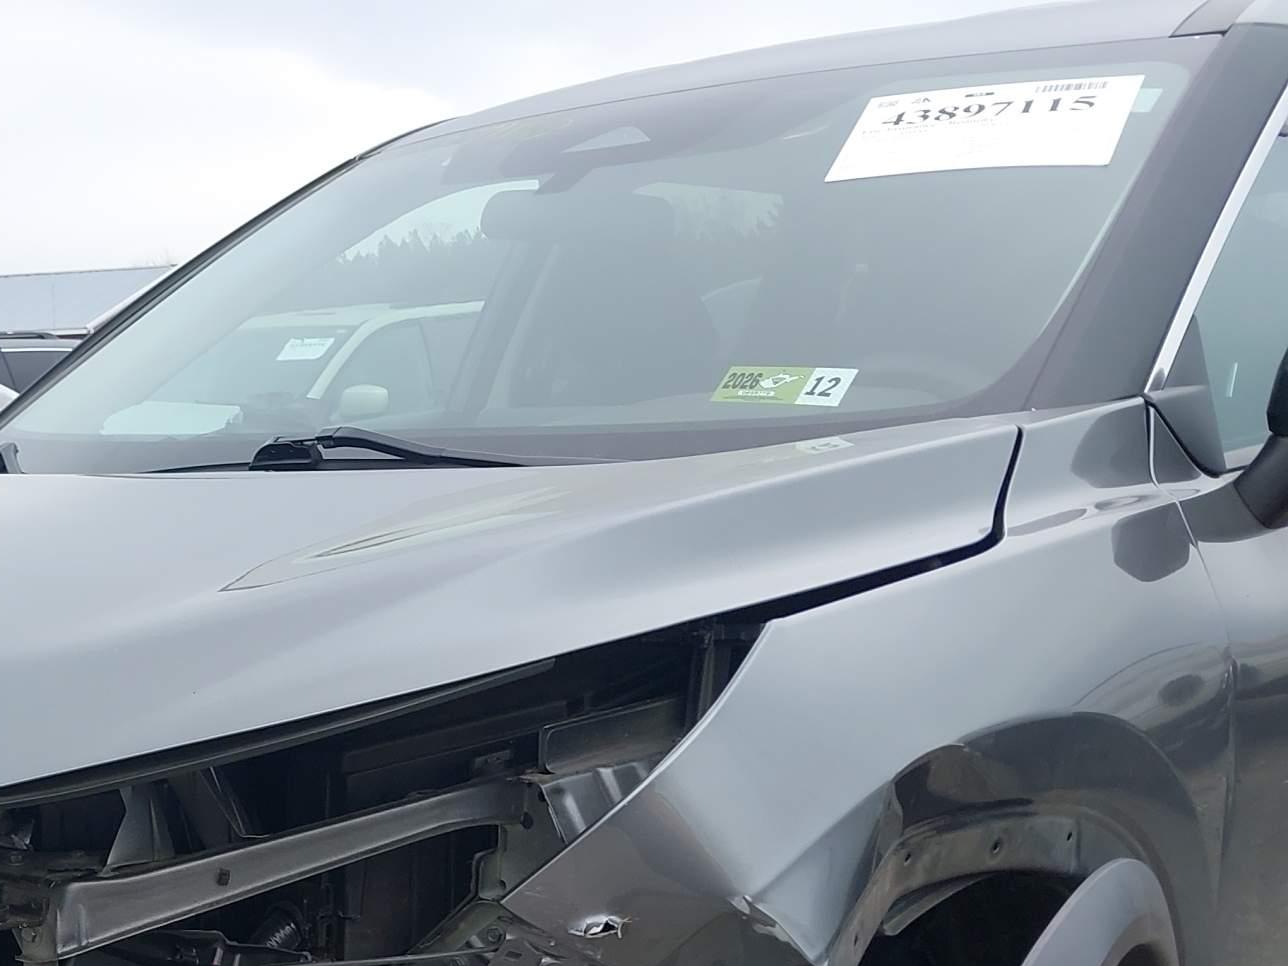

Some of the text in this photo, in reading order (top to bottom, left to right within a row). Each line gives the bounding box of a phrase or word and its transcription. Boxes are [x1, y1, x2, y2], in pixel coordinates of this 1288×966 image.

[882, 95, 1096, 125] 43897115
[723, 372, 763, 389] 2026
[805, 376, 841, 397] 12
